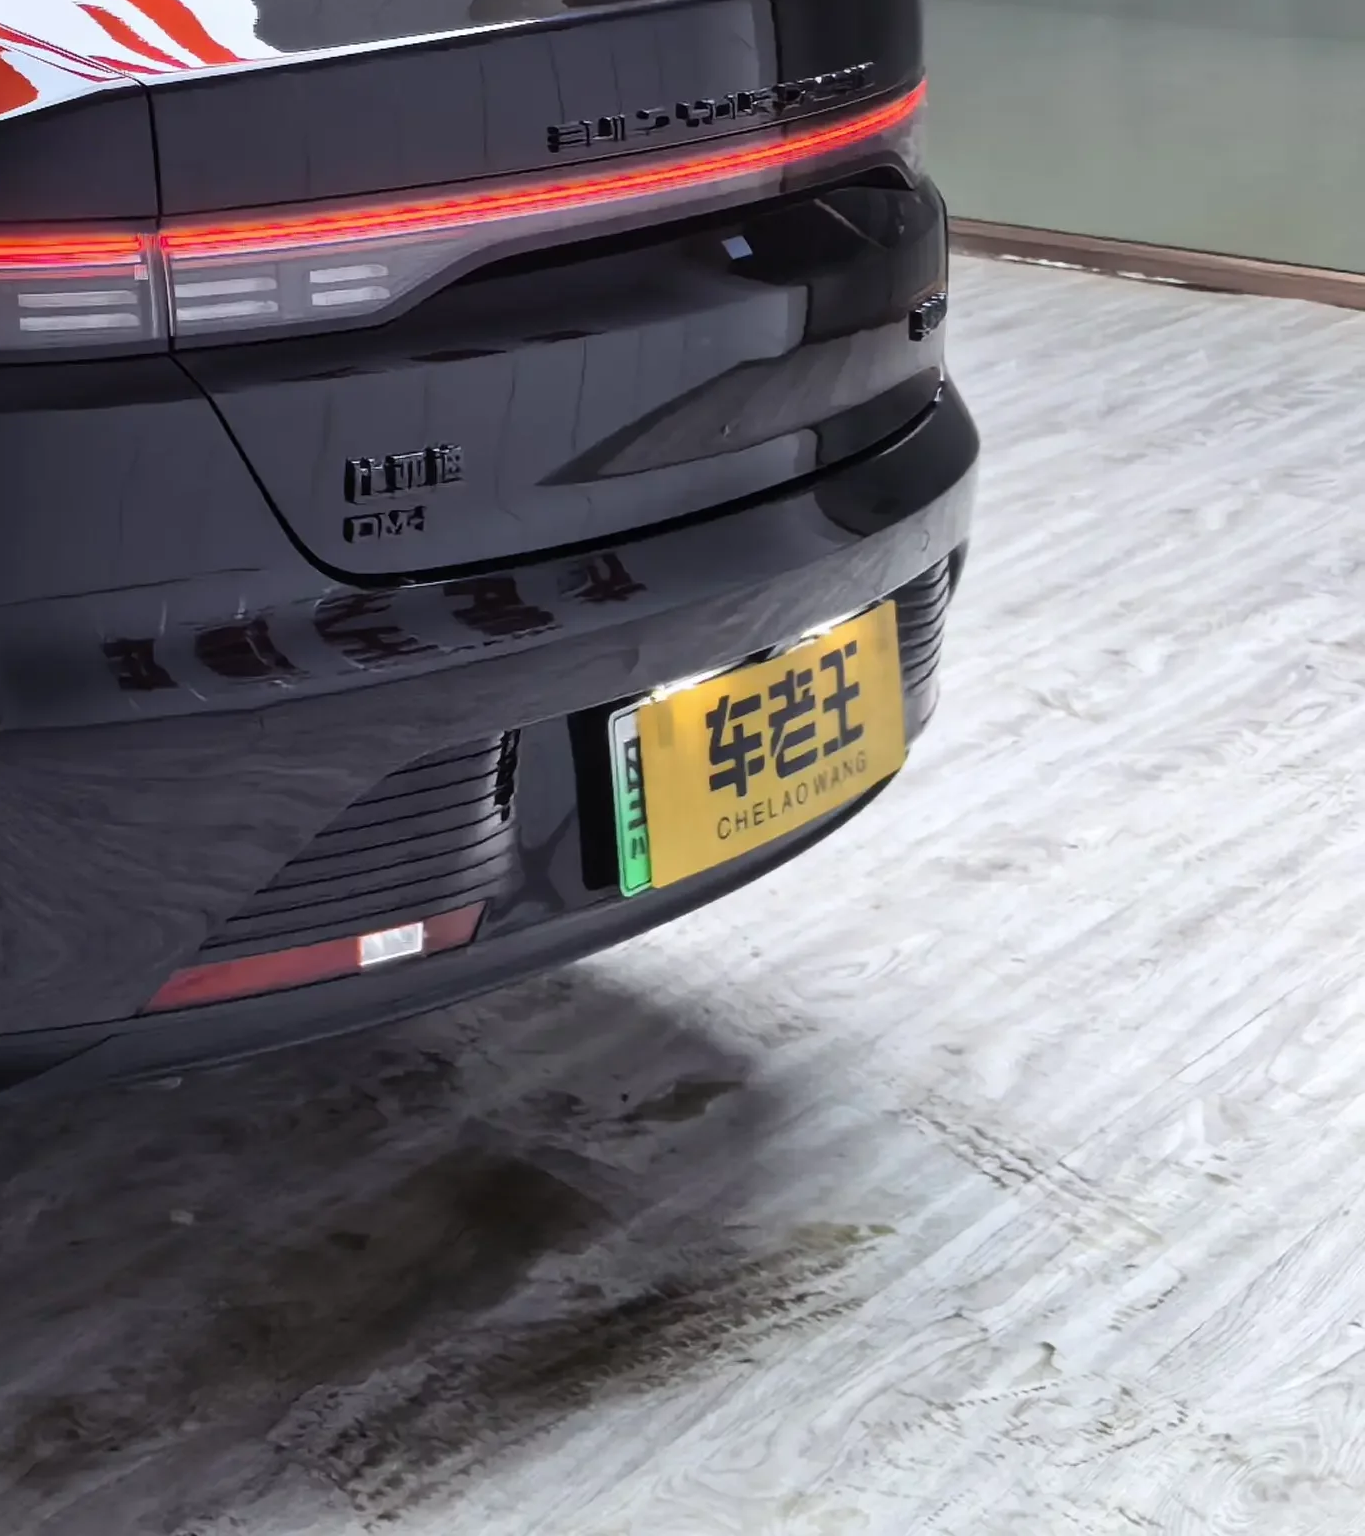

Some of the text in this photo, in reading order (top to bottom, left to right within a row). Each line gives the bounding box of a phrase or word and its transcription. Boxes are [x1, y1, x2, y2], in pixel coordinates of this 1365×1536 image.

[705, 640, 864, 798] 车老王
[717, 750, 867, 840] CHELAOWANG
